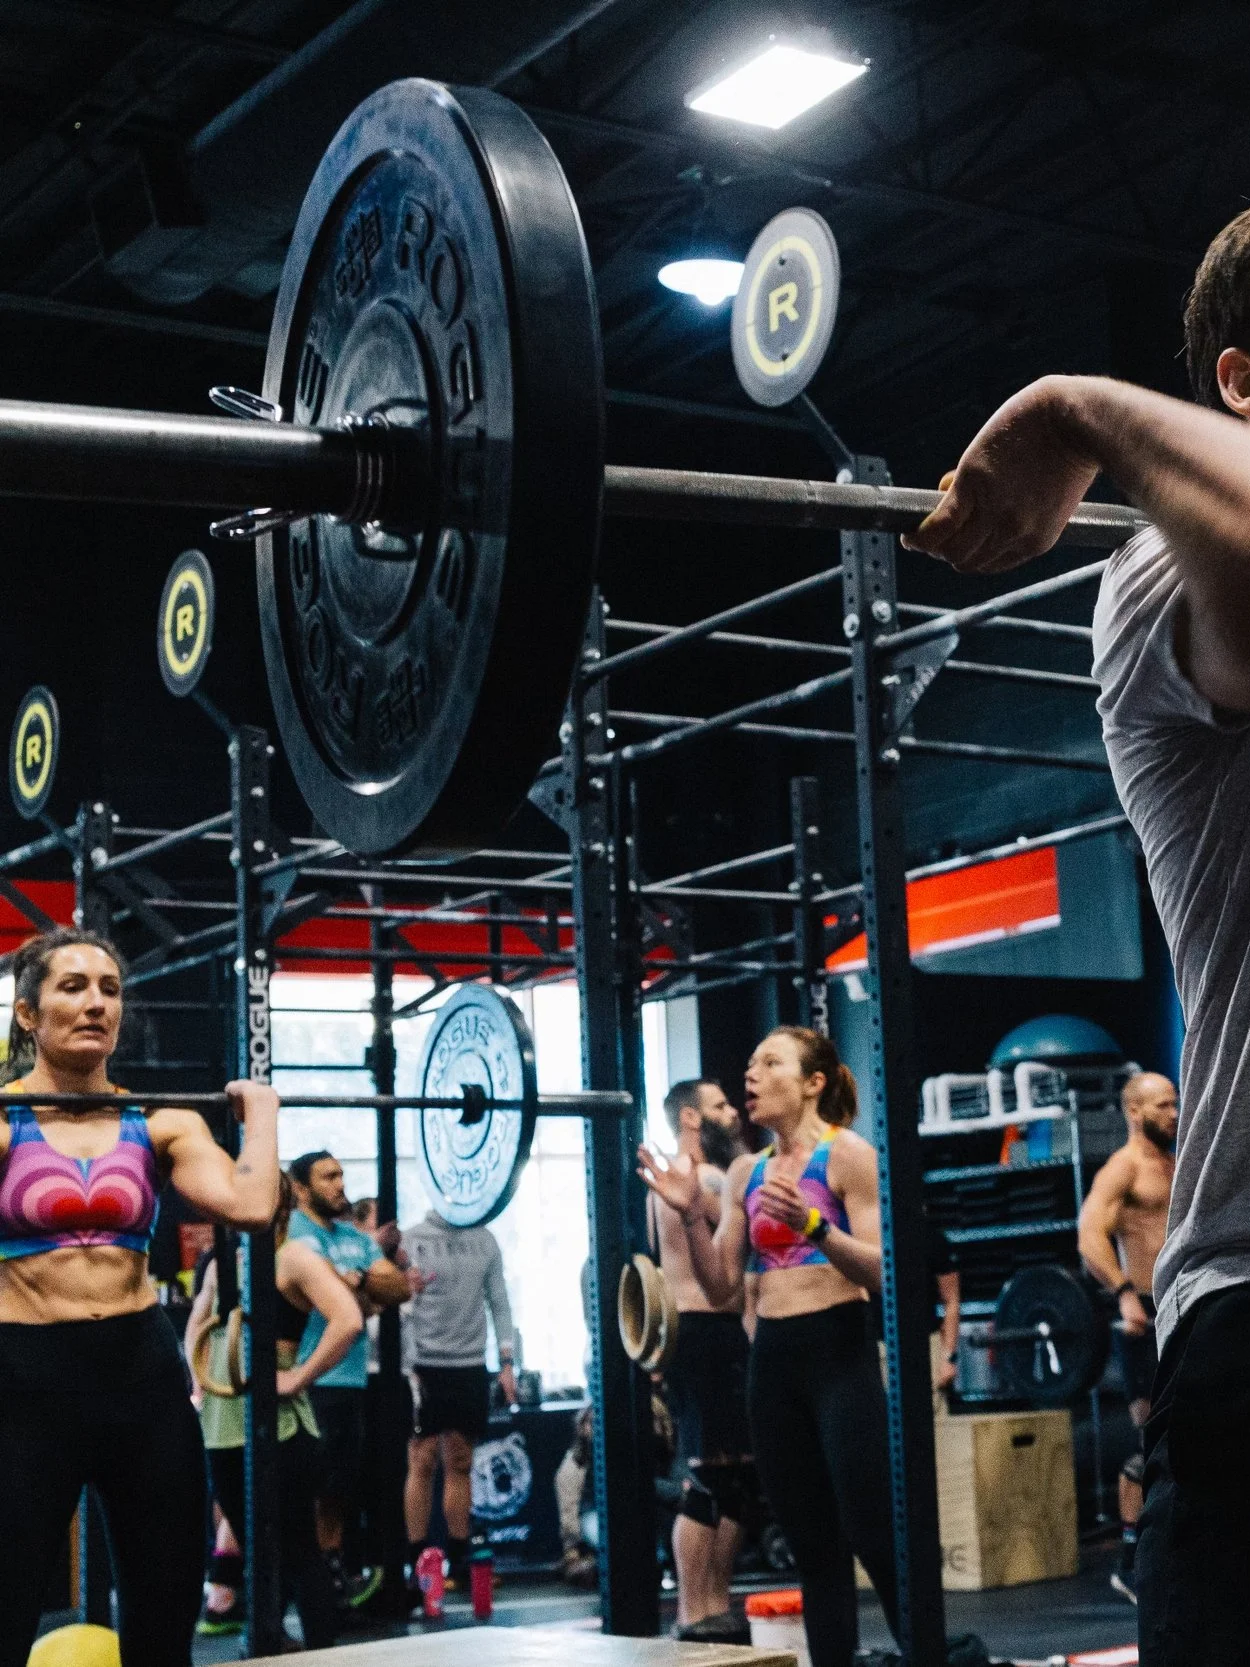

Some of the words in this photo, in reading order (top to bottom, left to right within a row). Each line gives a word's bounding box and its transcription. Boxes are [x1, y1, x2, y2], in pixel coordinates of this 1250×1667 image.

[768, 281, 800, 333] R
[176, 604, 194, 641] R
[26, 734, 41, 768] R
[248, 965, 271, 1086] ROGUE
